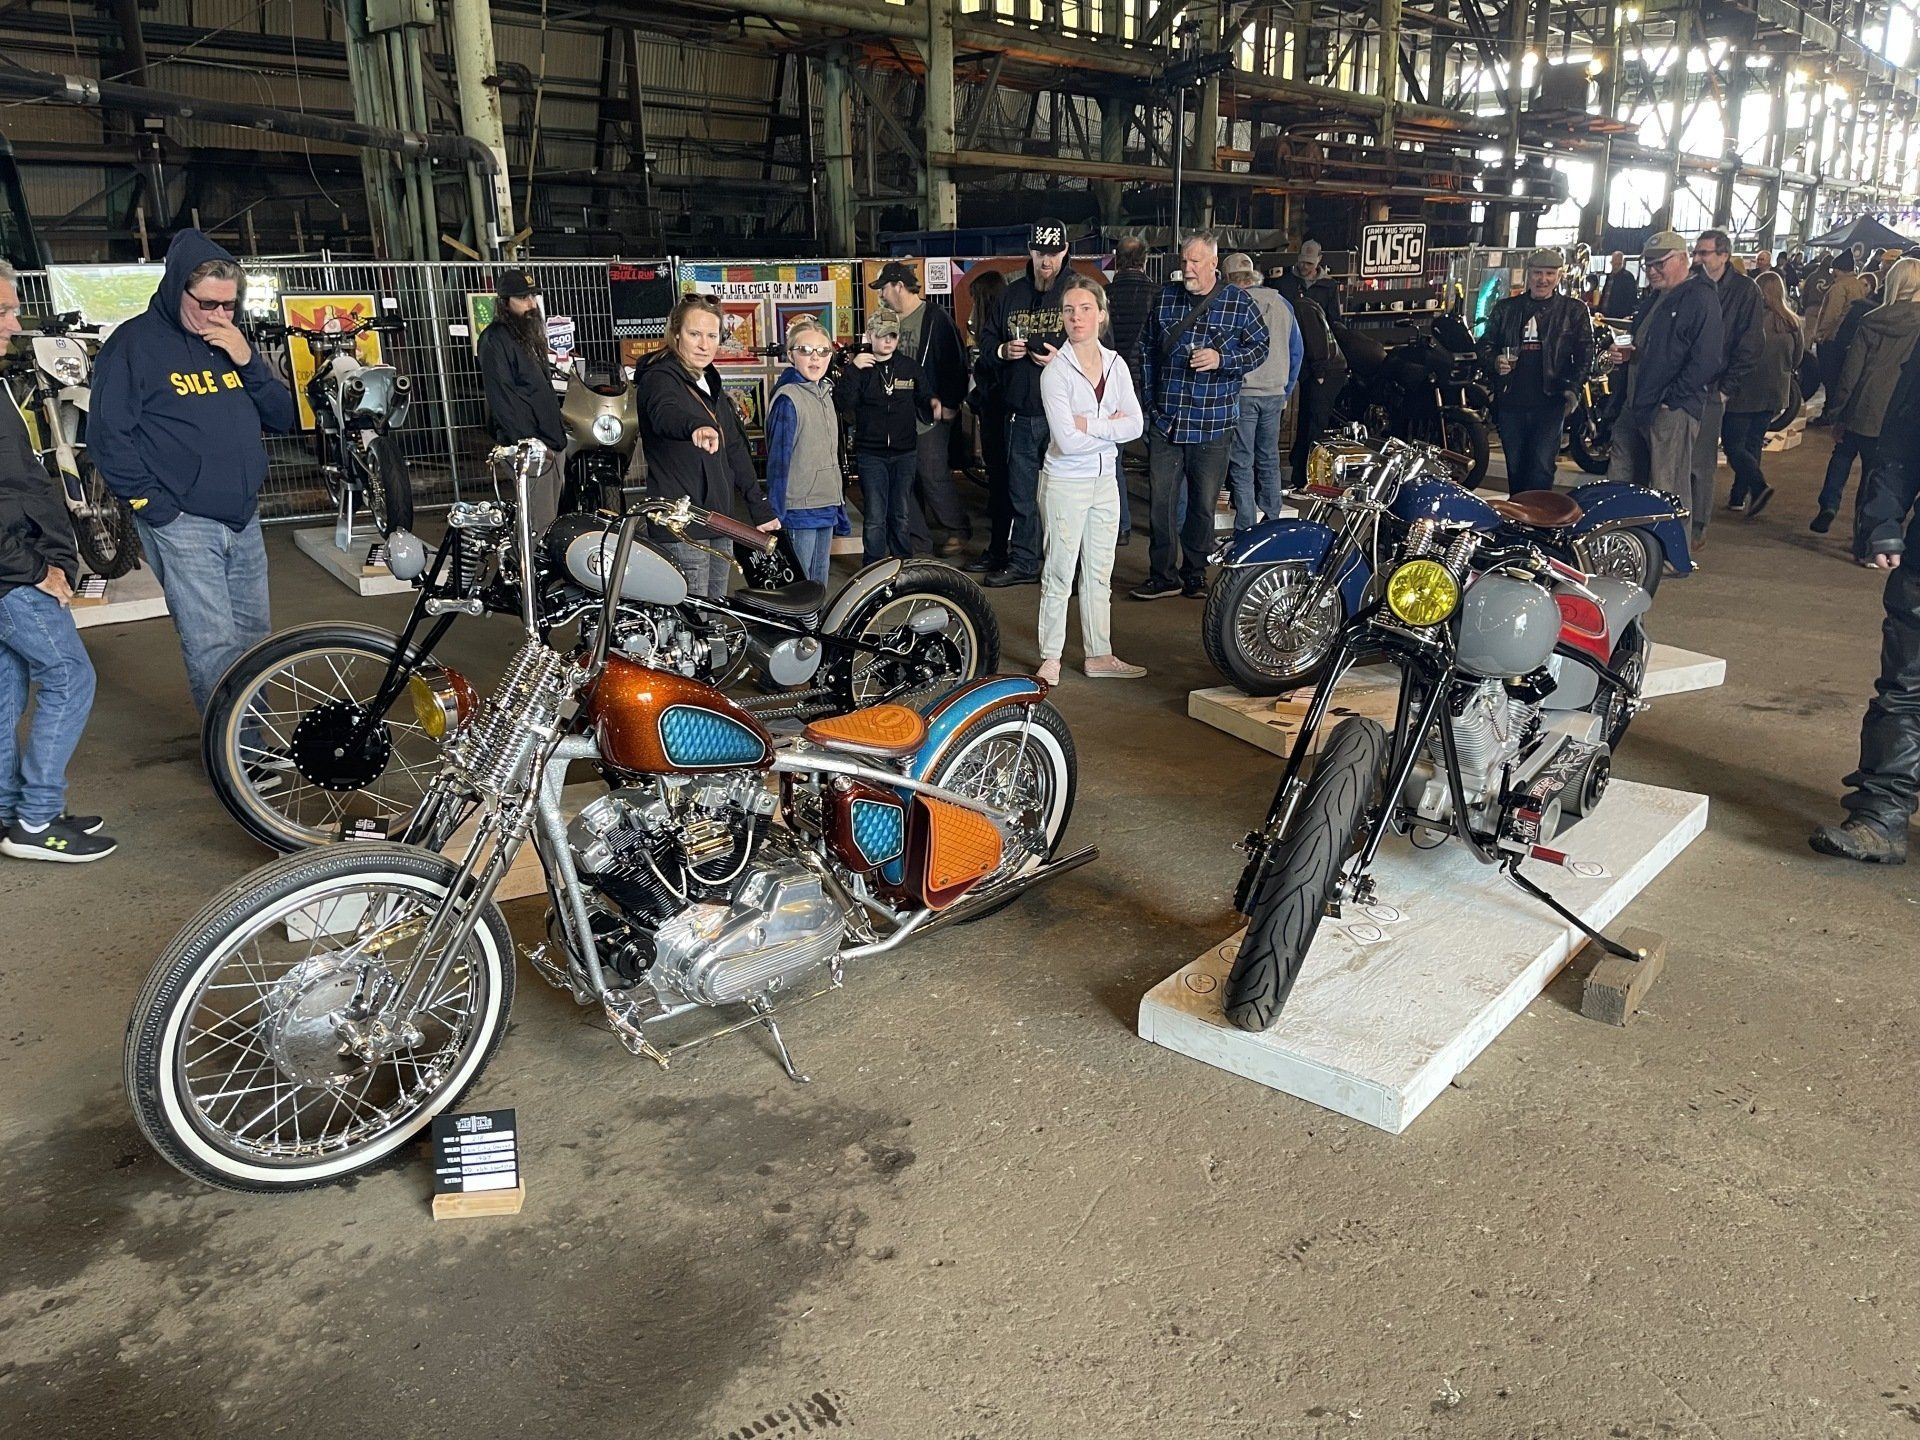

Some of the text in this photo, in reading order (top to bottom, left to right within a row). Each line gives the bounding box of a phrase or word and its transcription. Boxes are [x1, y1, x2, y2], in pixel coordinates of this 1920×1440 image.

[1399, 226, 1416, 234] SUPPLY
[711, 283, 818, 294] THE LIFE CYCLE OF A MOPED
[550, 334, 571, 346] $500
